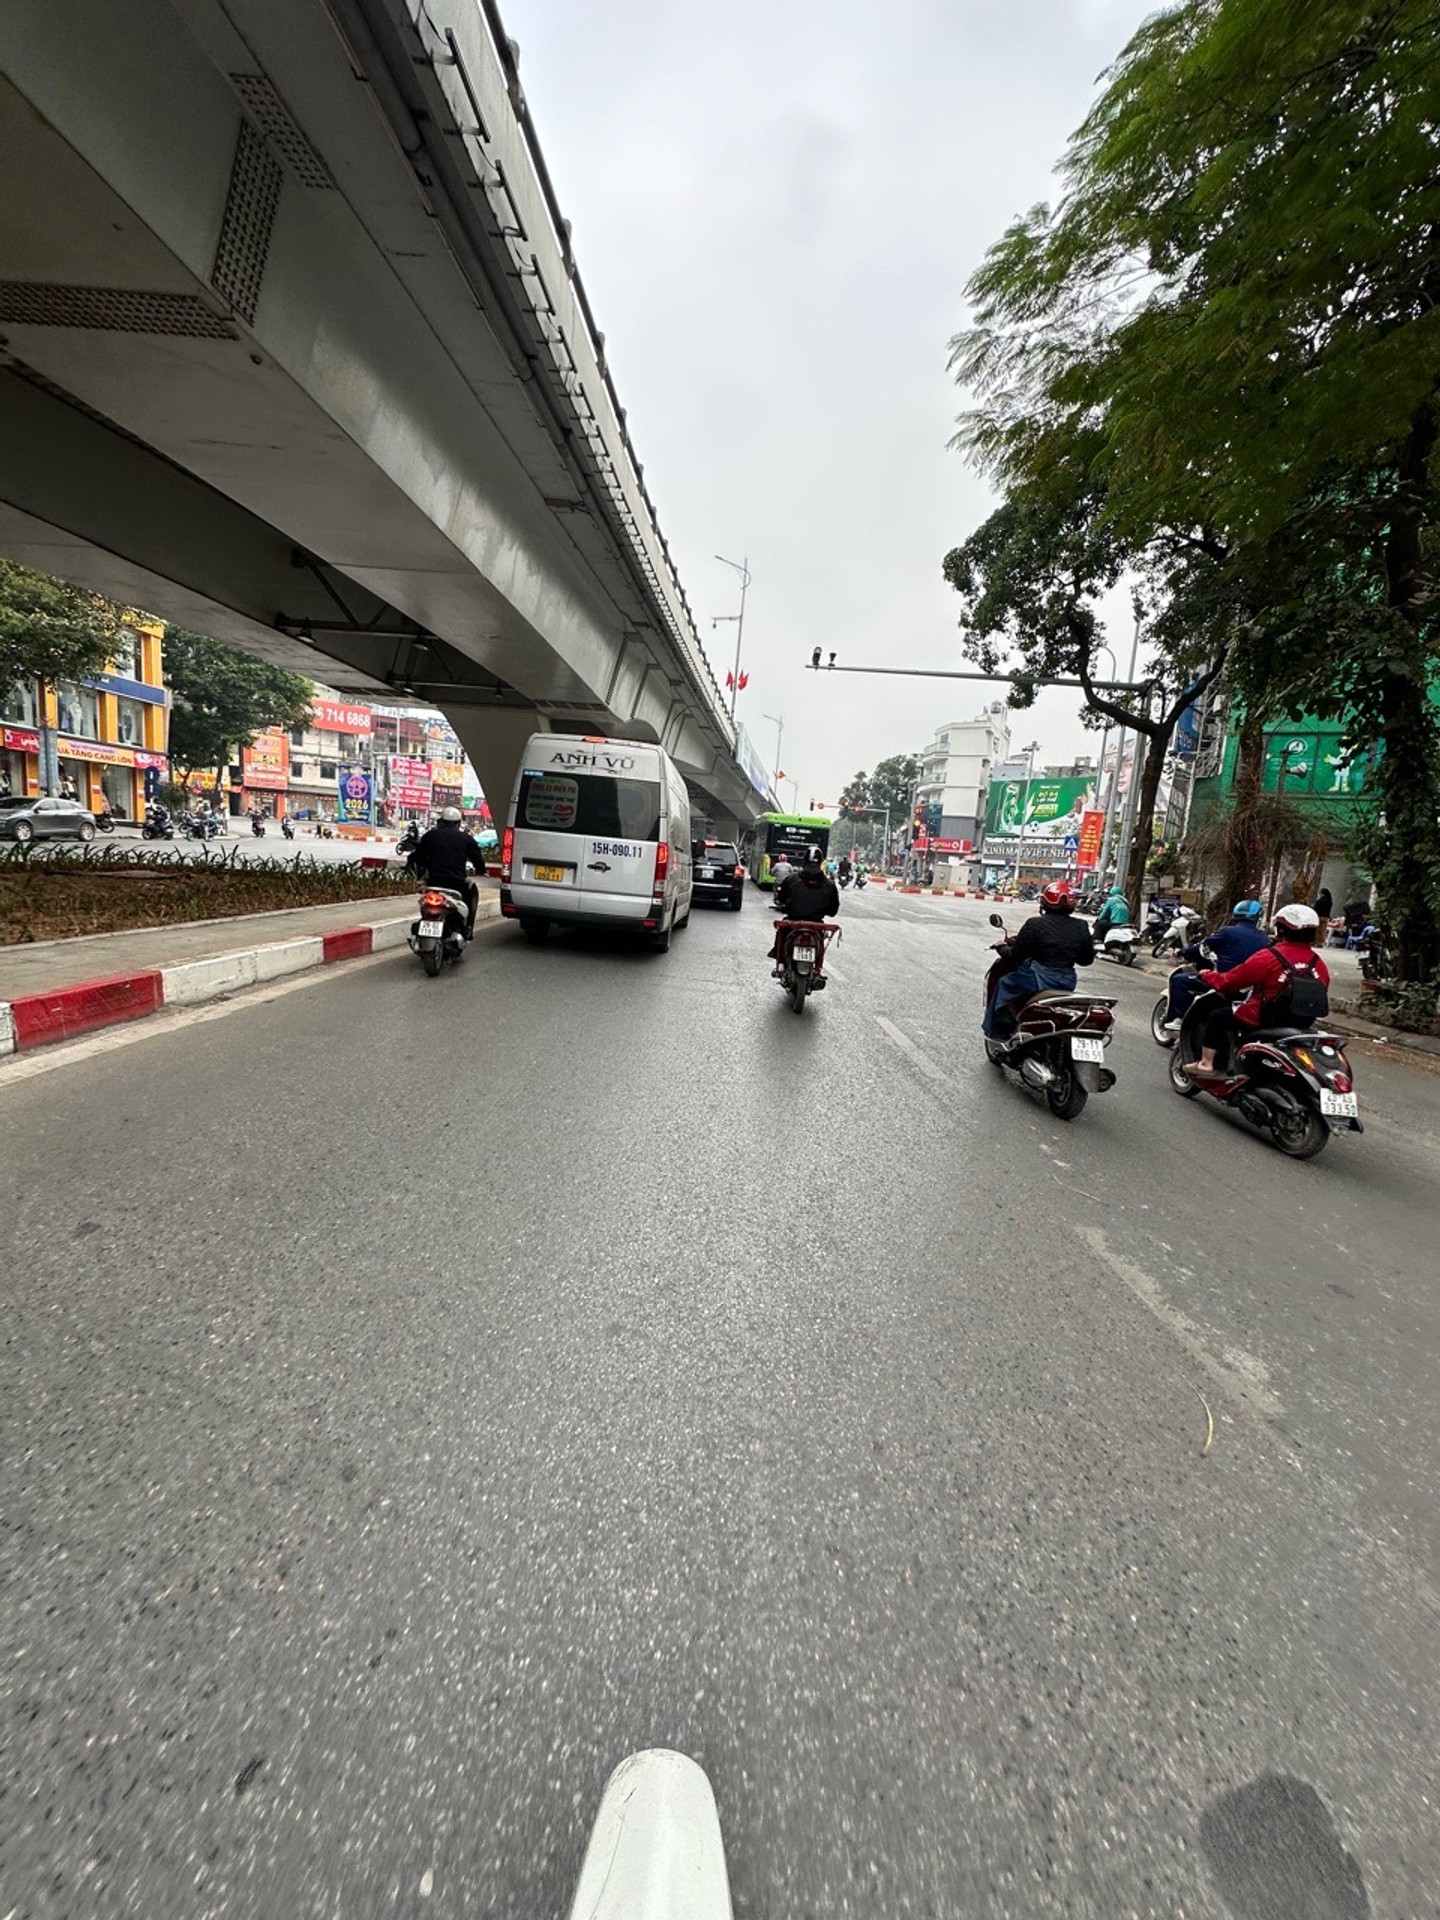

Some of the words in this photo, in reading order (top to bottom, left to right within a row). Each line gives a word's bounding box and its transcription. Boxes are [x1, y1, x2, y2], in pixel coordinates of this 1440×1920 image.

[326, 708, 345, 724] 714
[346, 711, 371, 728] 6868
[550, 752, 597, 766] ANH
[345, 799, 369, 810] 2026
[592, 842, 643, 859] 15H-090.11
